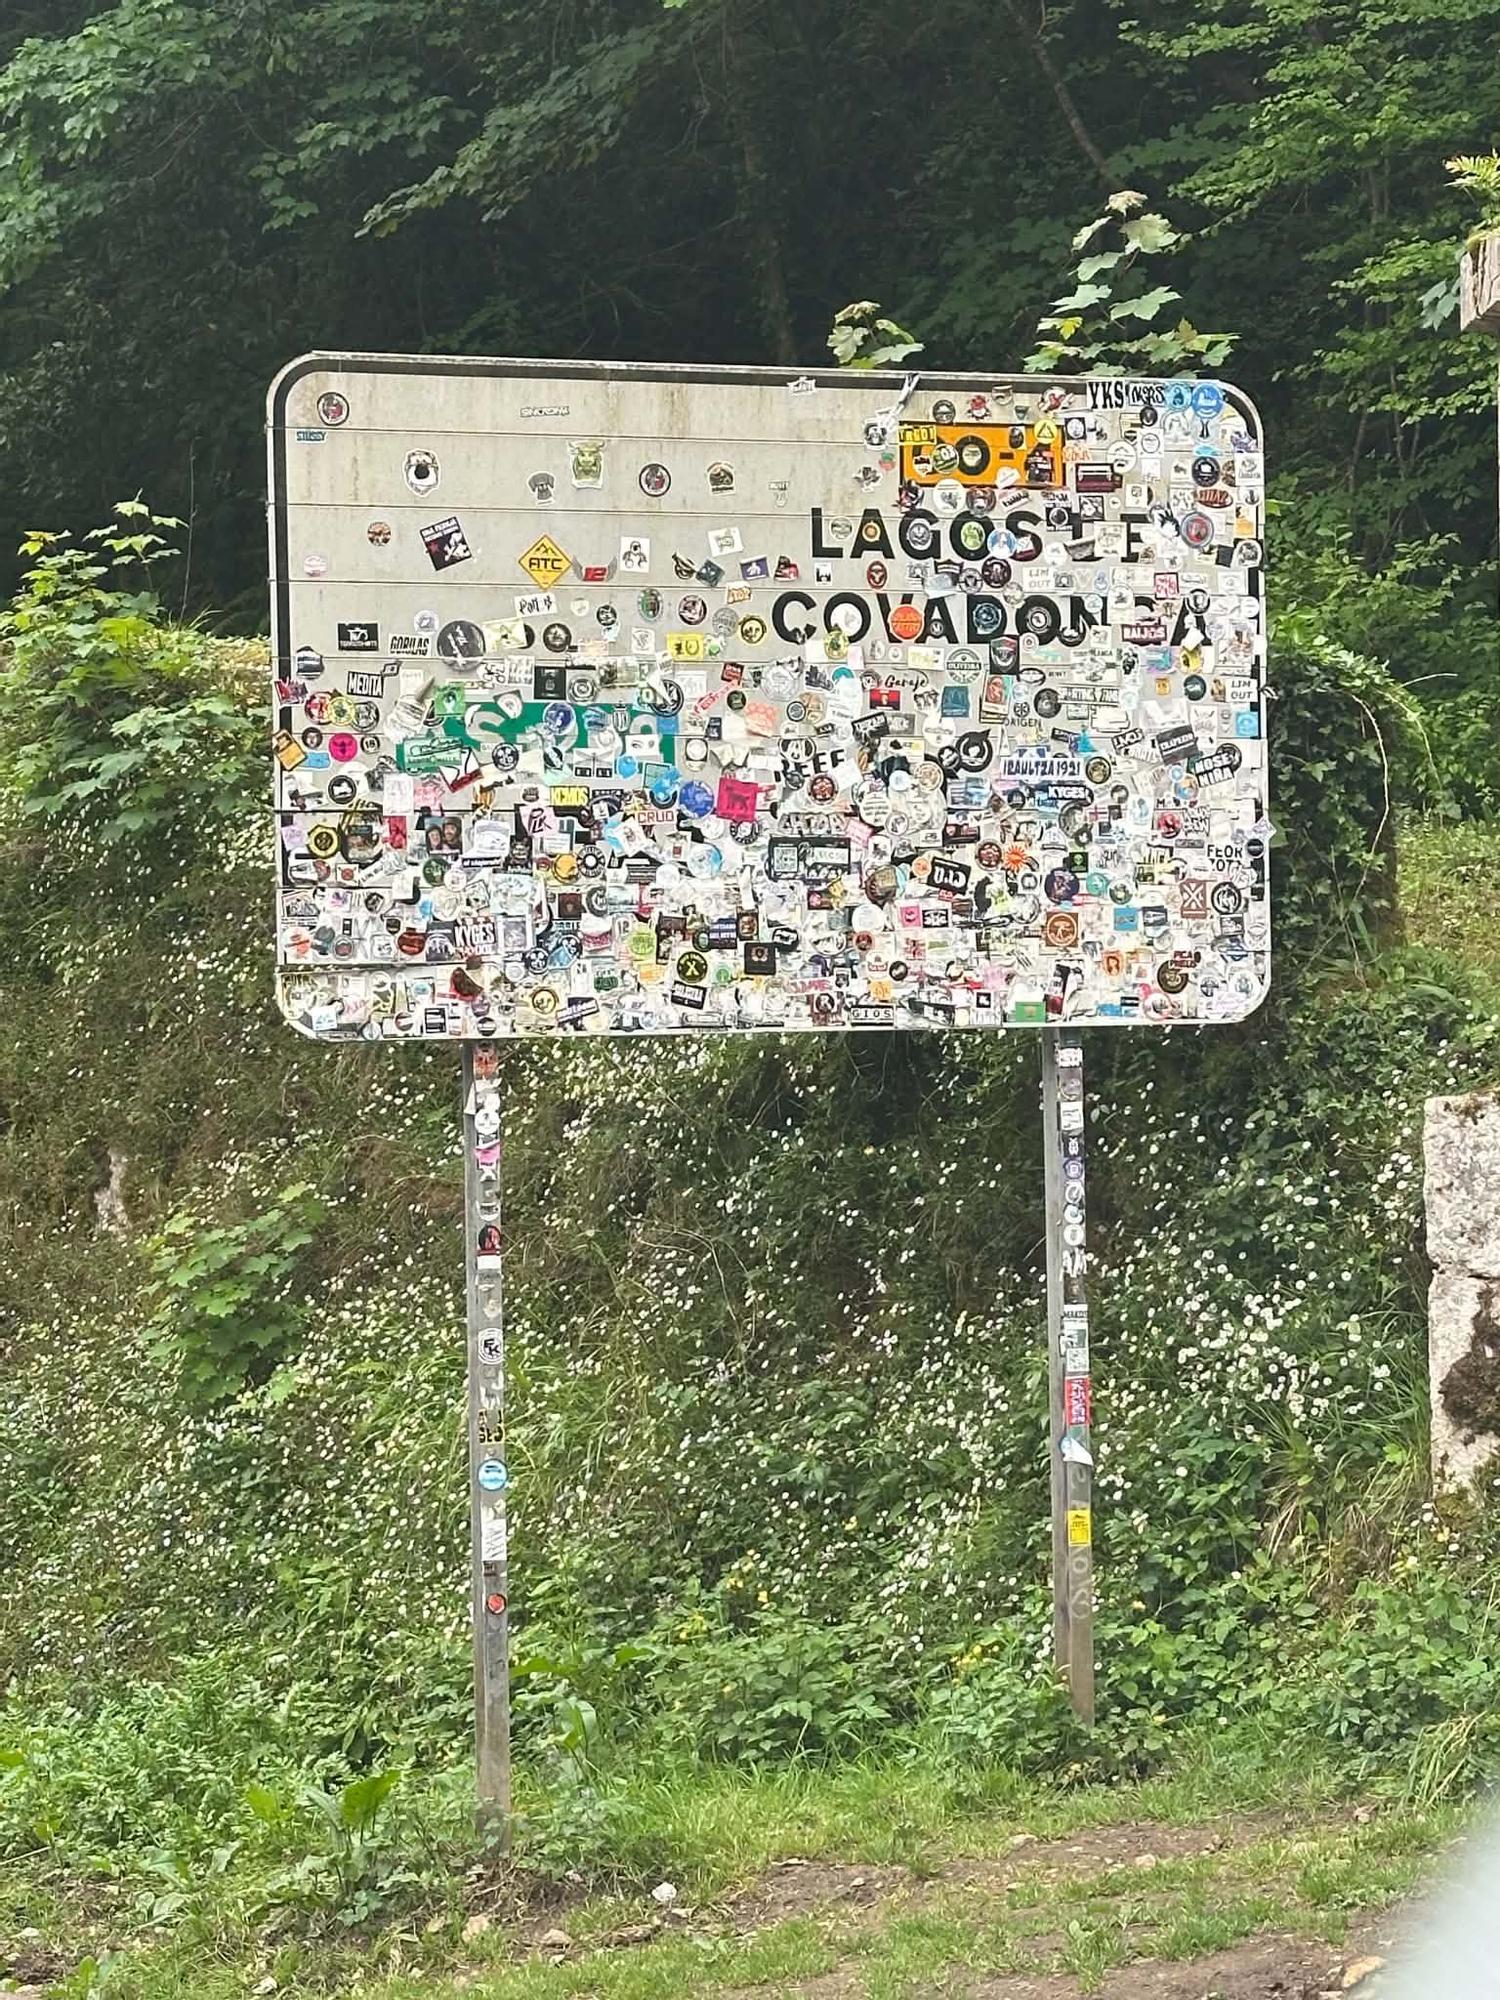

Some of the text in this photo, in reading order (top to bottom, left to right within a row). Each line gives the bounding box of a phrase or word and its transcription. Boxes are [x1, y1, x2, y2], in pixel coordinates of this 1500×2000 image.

[1088, 381, 1124, 409] YKS
[811, 507, 1043, 562] LAGOS
[528, 557, 563, 570] ATC
[348, 672, 383, 696] MEDITA
